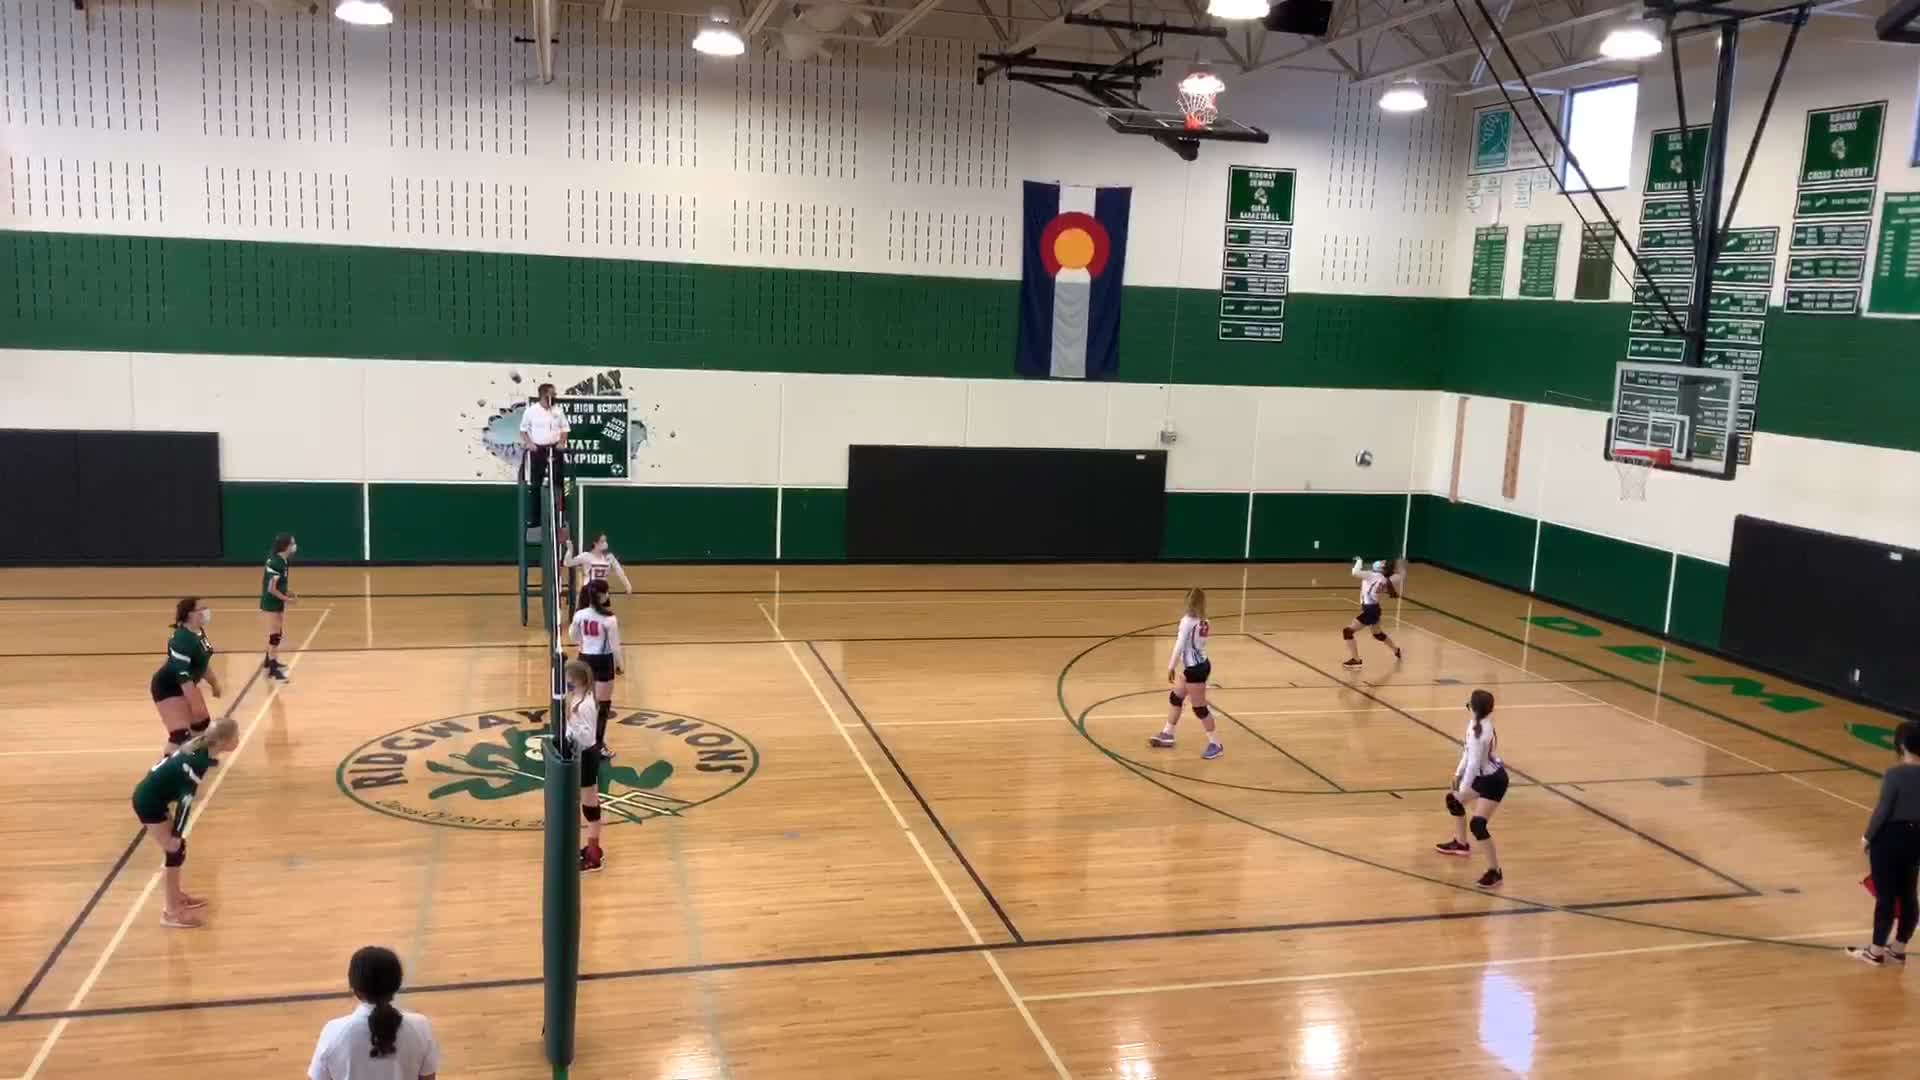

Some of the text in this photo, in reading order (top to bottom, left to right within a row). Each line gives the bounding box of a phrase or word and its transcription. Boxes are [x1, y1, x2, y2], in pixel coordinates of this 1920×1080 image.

[1807, 167, 1869, 180] CROSS COUNTRY
[574, 403, 594, 413] HIGH
[597, 403, 627, 413] SCHOOL
[589, 415, 603, 424] AA
[568, 439, 601, 450] TATE
[349, 709, 749, 790] RIDGWAY EMONS
